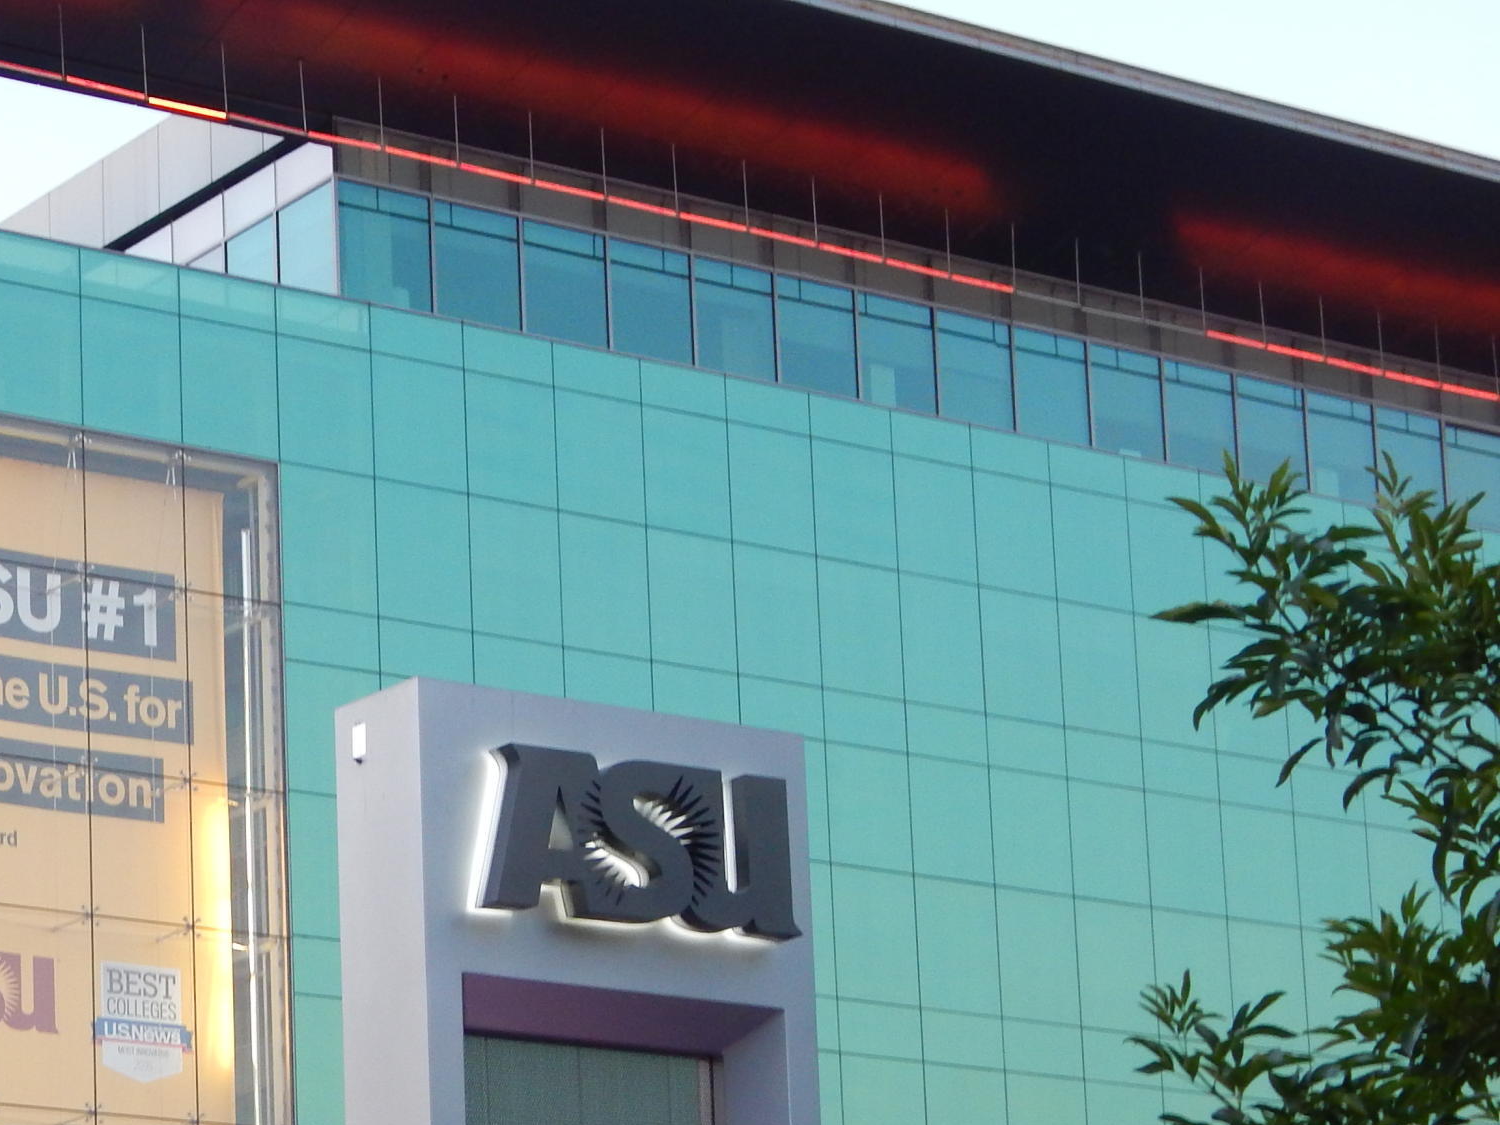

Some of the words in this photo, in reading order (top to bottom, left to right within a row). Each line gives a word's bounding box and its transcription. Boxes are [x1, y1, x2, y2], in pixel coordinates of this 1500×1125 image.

[82, 580, 157, 647] #1
[39, 673, 117, 721] U.S.
[123, 684, 182, 729] for
[473, 743, 802, 942] ASU
[106, 968, 176, 999] BEST
[107, 997, 177, 1021] COLLEGES
